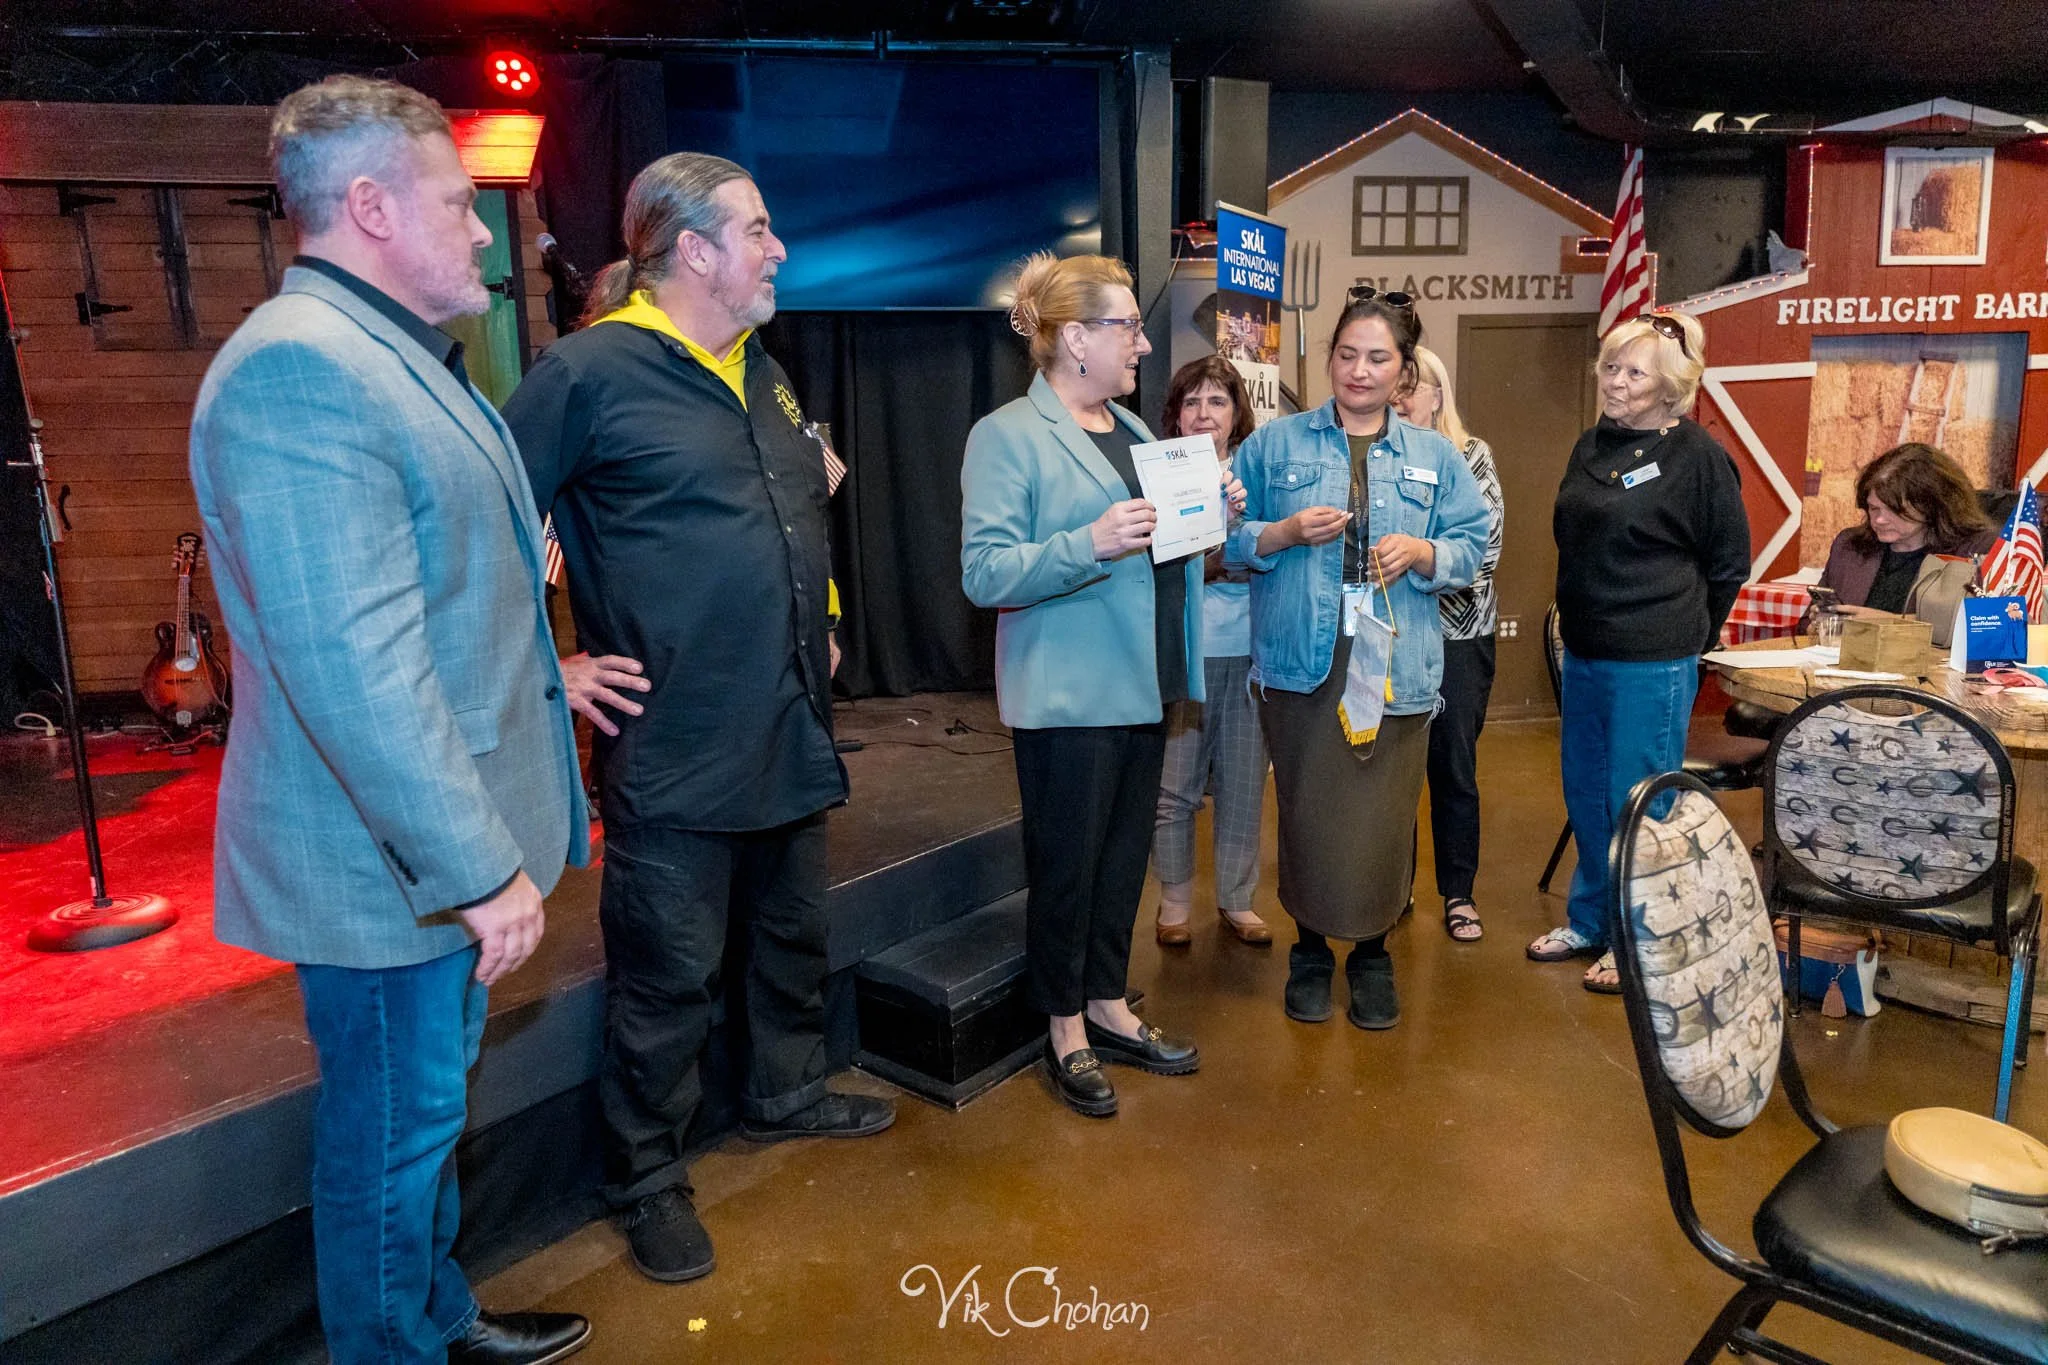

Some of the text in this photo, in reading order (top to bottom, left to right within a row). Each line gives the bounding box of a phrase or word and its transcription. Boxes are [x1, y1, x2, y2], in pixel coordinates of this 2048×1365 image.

[1241, 228, 1267, 255] SKÅL
[1223, 247, 1280, 277] INTERNATIONAL
[1231, 266, 1275, 293] LAS VEGAS
[1776, 295, 1960, 326] FIRELIGHT
[1242, 371, 1276, 410] KÅL
